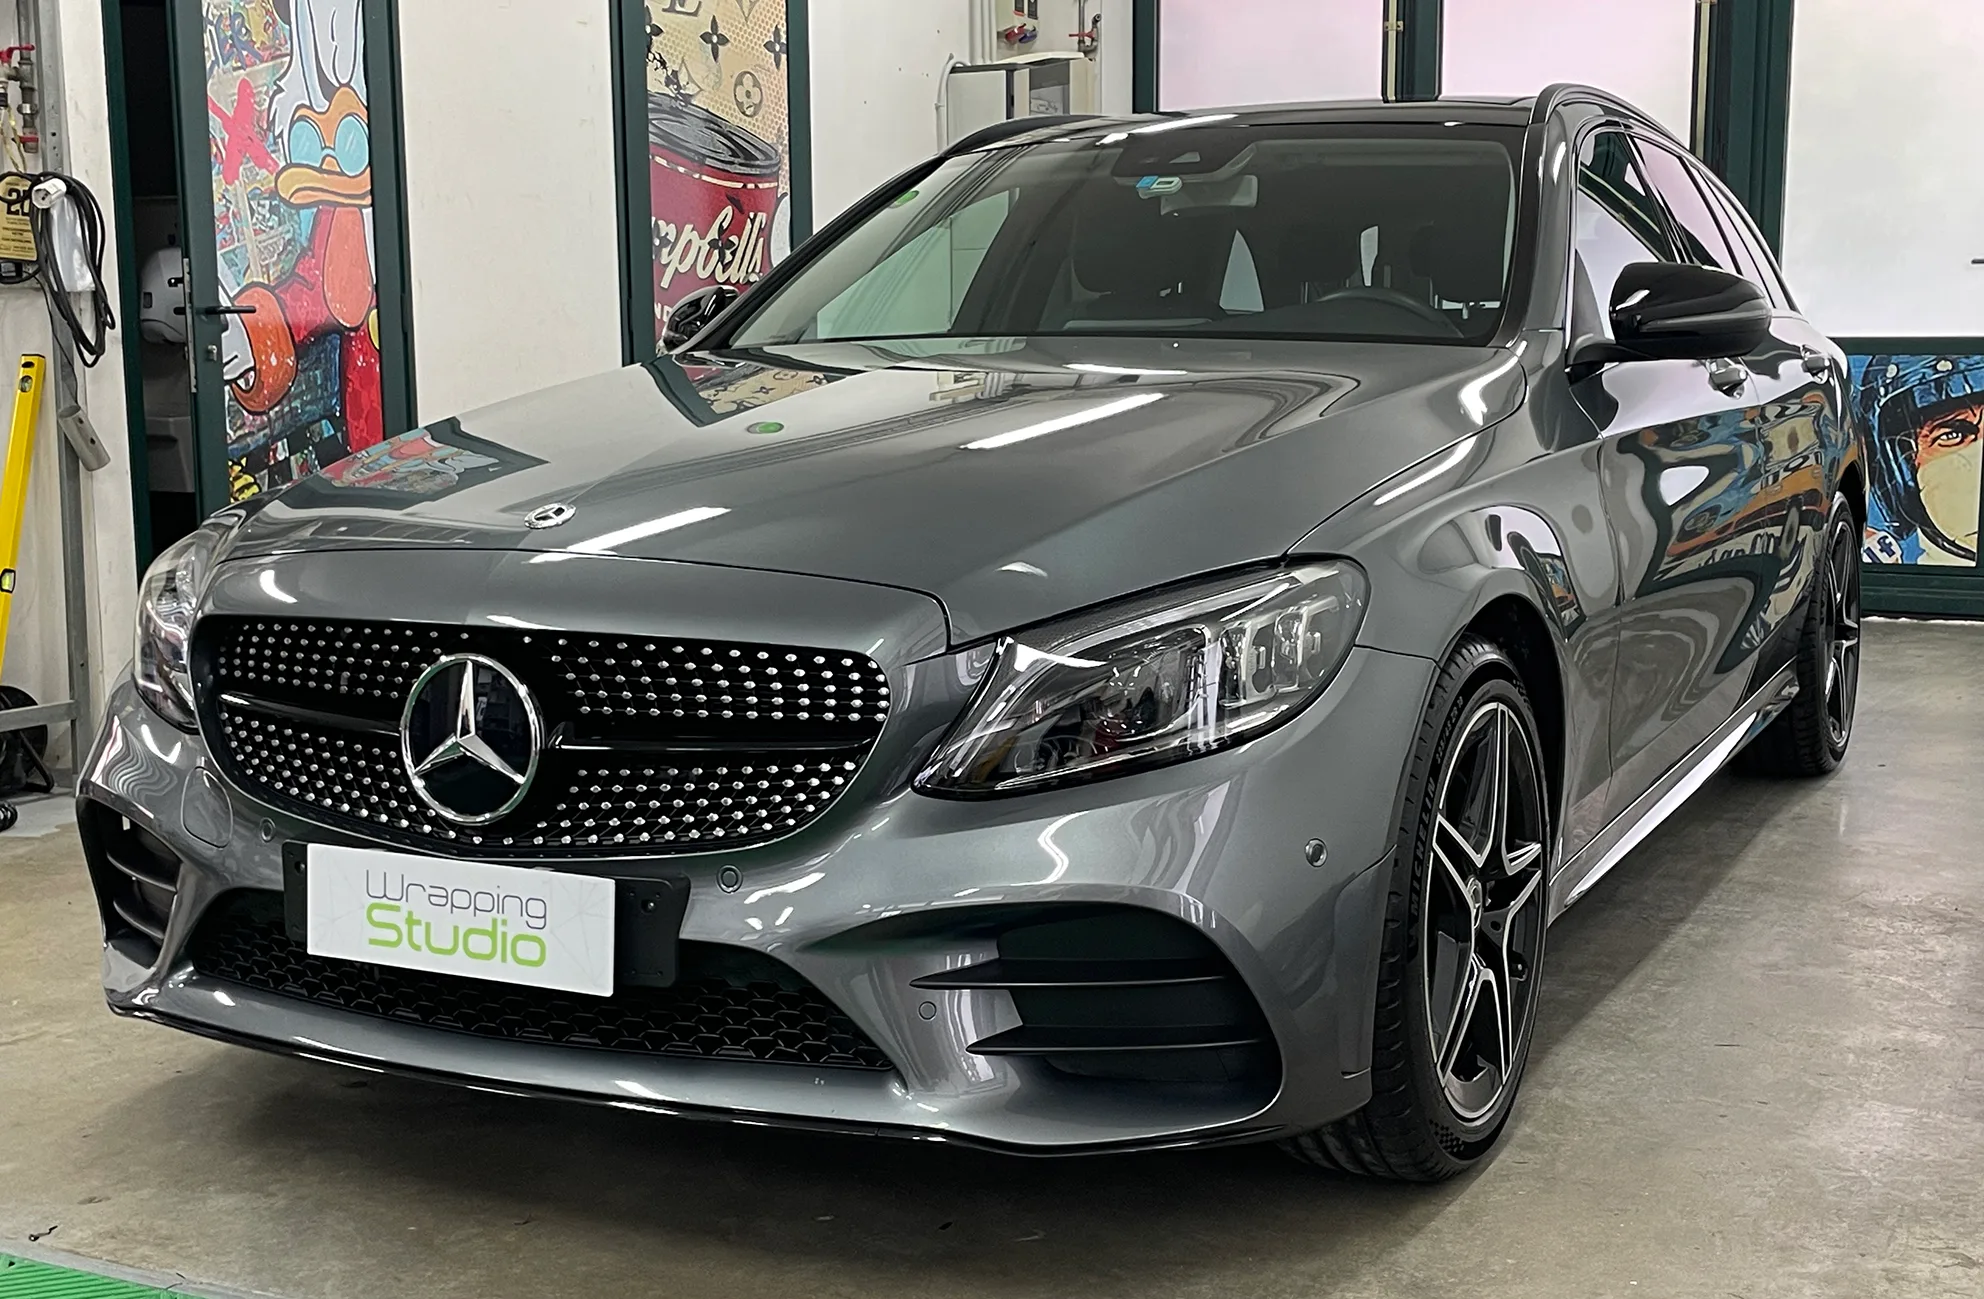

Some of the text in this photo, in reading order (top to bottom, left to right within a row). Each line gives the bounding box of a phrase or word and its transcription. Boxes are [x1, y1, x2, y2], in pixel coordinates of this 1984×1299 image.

[1410, 776, 1436, 916] MICHELIN
[366, 869, 548, 930] Wrapping
[366, 902, 547, 968] Studio
